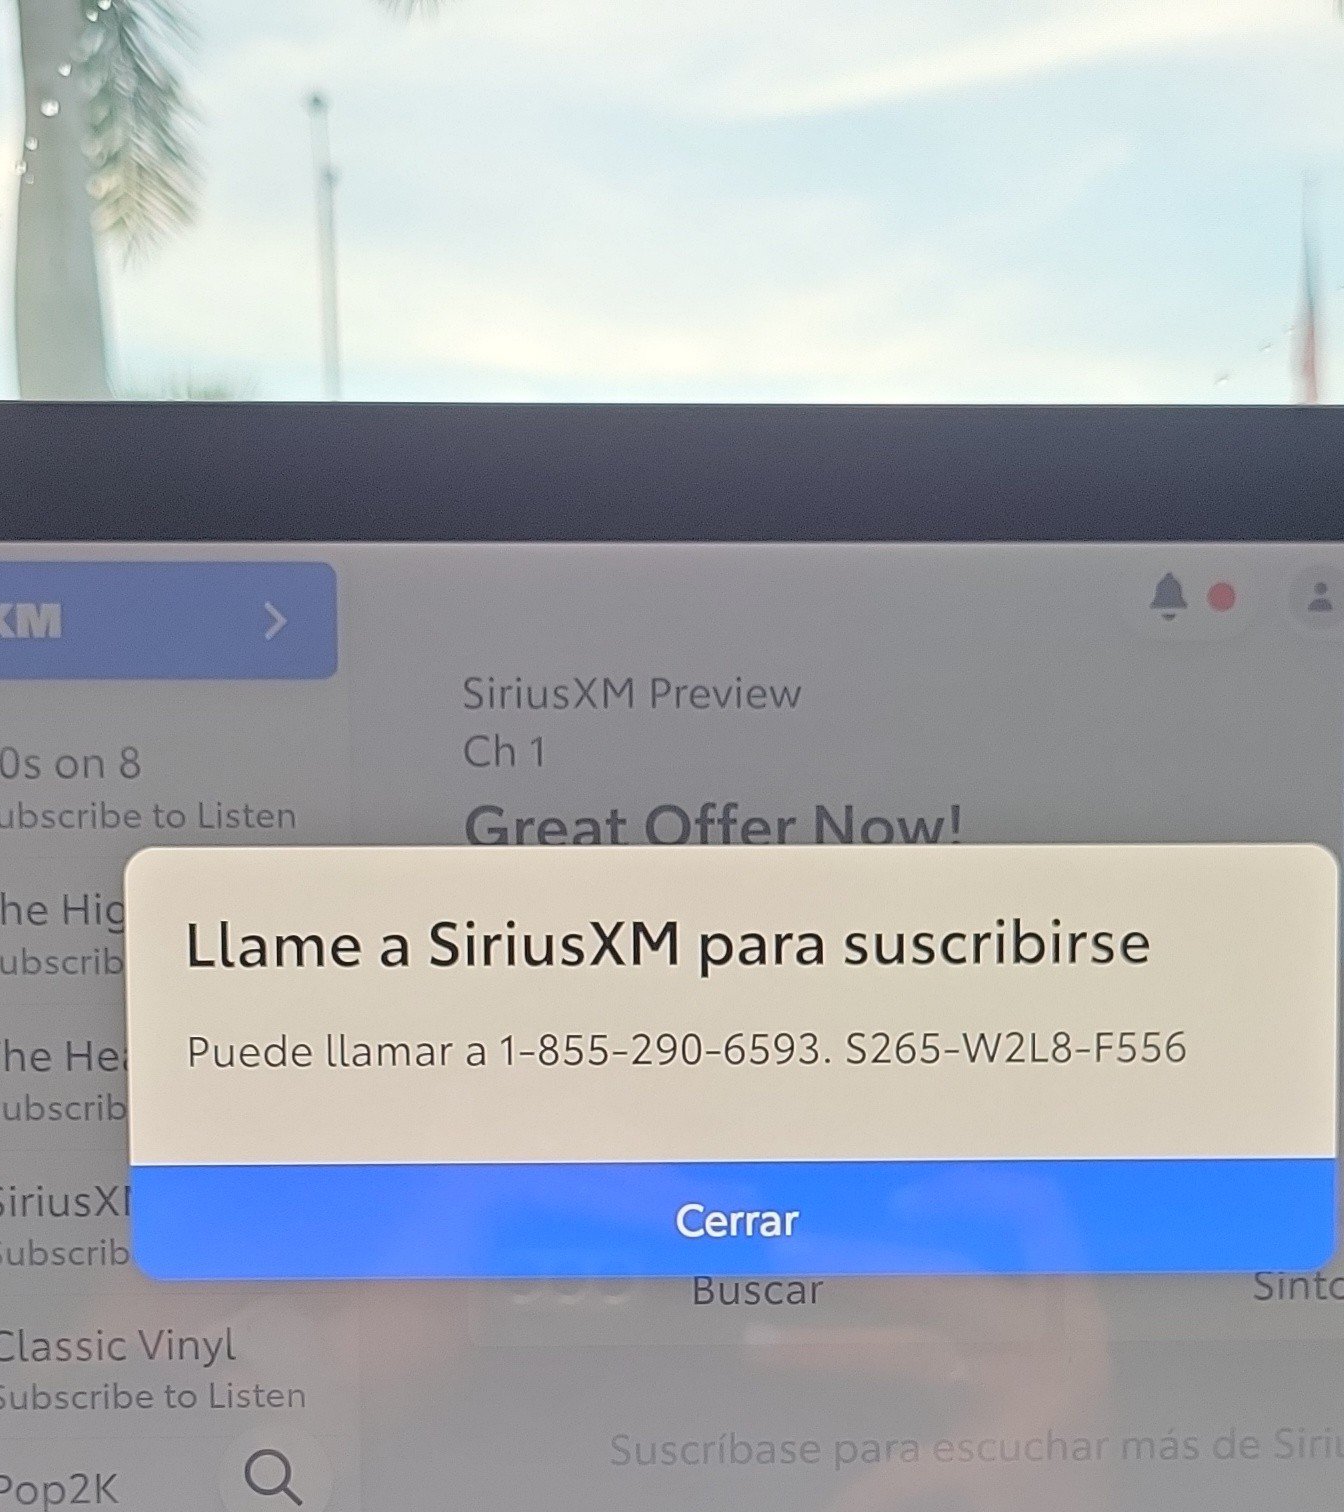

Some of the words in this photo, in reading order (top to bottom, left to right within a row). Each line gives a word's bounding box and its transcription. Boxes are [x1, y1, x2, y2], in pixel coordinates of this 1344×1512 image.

[463, 677, 635, 711] SiriusXM
[650, 677, 802, 709] Preview
[56, 753, 105, 779] on
[119, 745, 142, 779] 8
[463, 734, 516, 768] Ch
[531, 737, 545, 767] 1
[153, 806, 186, 830] to
[198, 801, 296, 830] Listen
[465, 804, 627, 845] Great
[645, 802, 796, 845] Offer
[188, 920, 362, 968] Llame
[381, 931, 410, 967] a
[429, 920, 678, 967] SiriusXM
[700, 930, 825, 977] para
[844, 918, 1151, 966] suscribirse
[66, 1040, 127, 1072] He
[189, 1034, 314, 1068] Puede
[326, 1034, 454, 1067] llamar
[466, 1043, 487, 1067] a
[501, 1032, 831, 1067] 1-855-290-6593.
[846, 1030, 1187, 1065] S265-W2L8-F556
[676, 1204, 800, 1238] Cerrar
[694, 1275, 823, 1305] Buscar
[138, 1328, 237, 1368] Vinyl
[164, 1386, 197, 1411] to
[208, 1381, 307, 1409] Listen
[611, 1431, 822, 1467] Suscríbase
[834, 1438, 919, 1470] para
[933, 1426, 1109, 1464] escuchar
[1121, 1424, 1200, 1462] más
[1213, 1424, 1261, 1460] de
